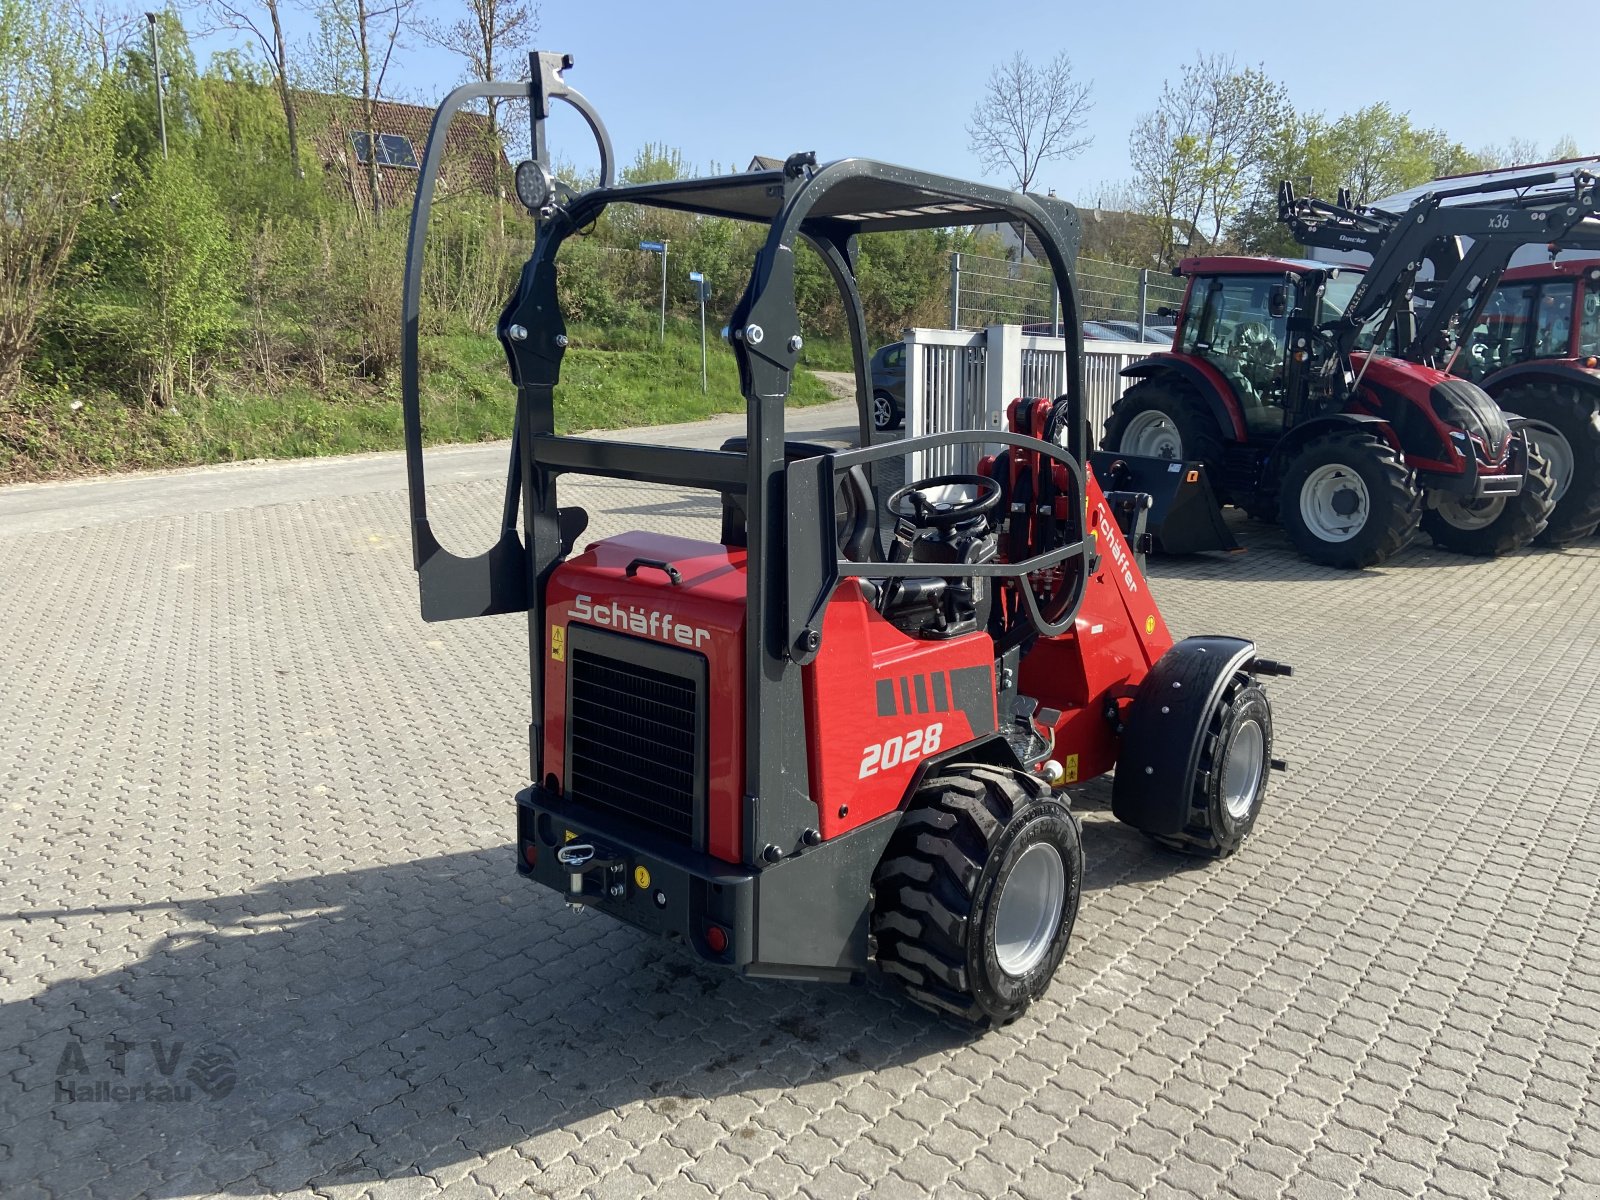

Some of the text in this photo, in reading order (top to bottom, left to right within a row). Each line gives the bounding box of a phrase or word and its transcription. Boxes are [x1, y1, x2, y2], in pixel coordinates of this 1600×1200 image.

[1488, 214, 1510, 229] x36
[567, 594, 711, 648] Schäffer
[858, 722, 943, 780] 2028
